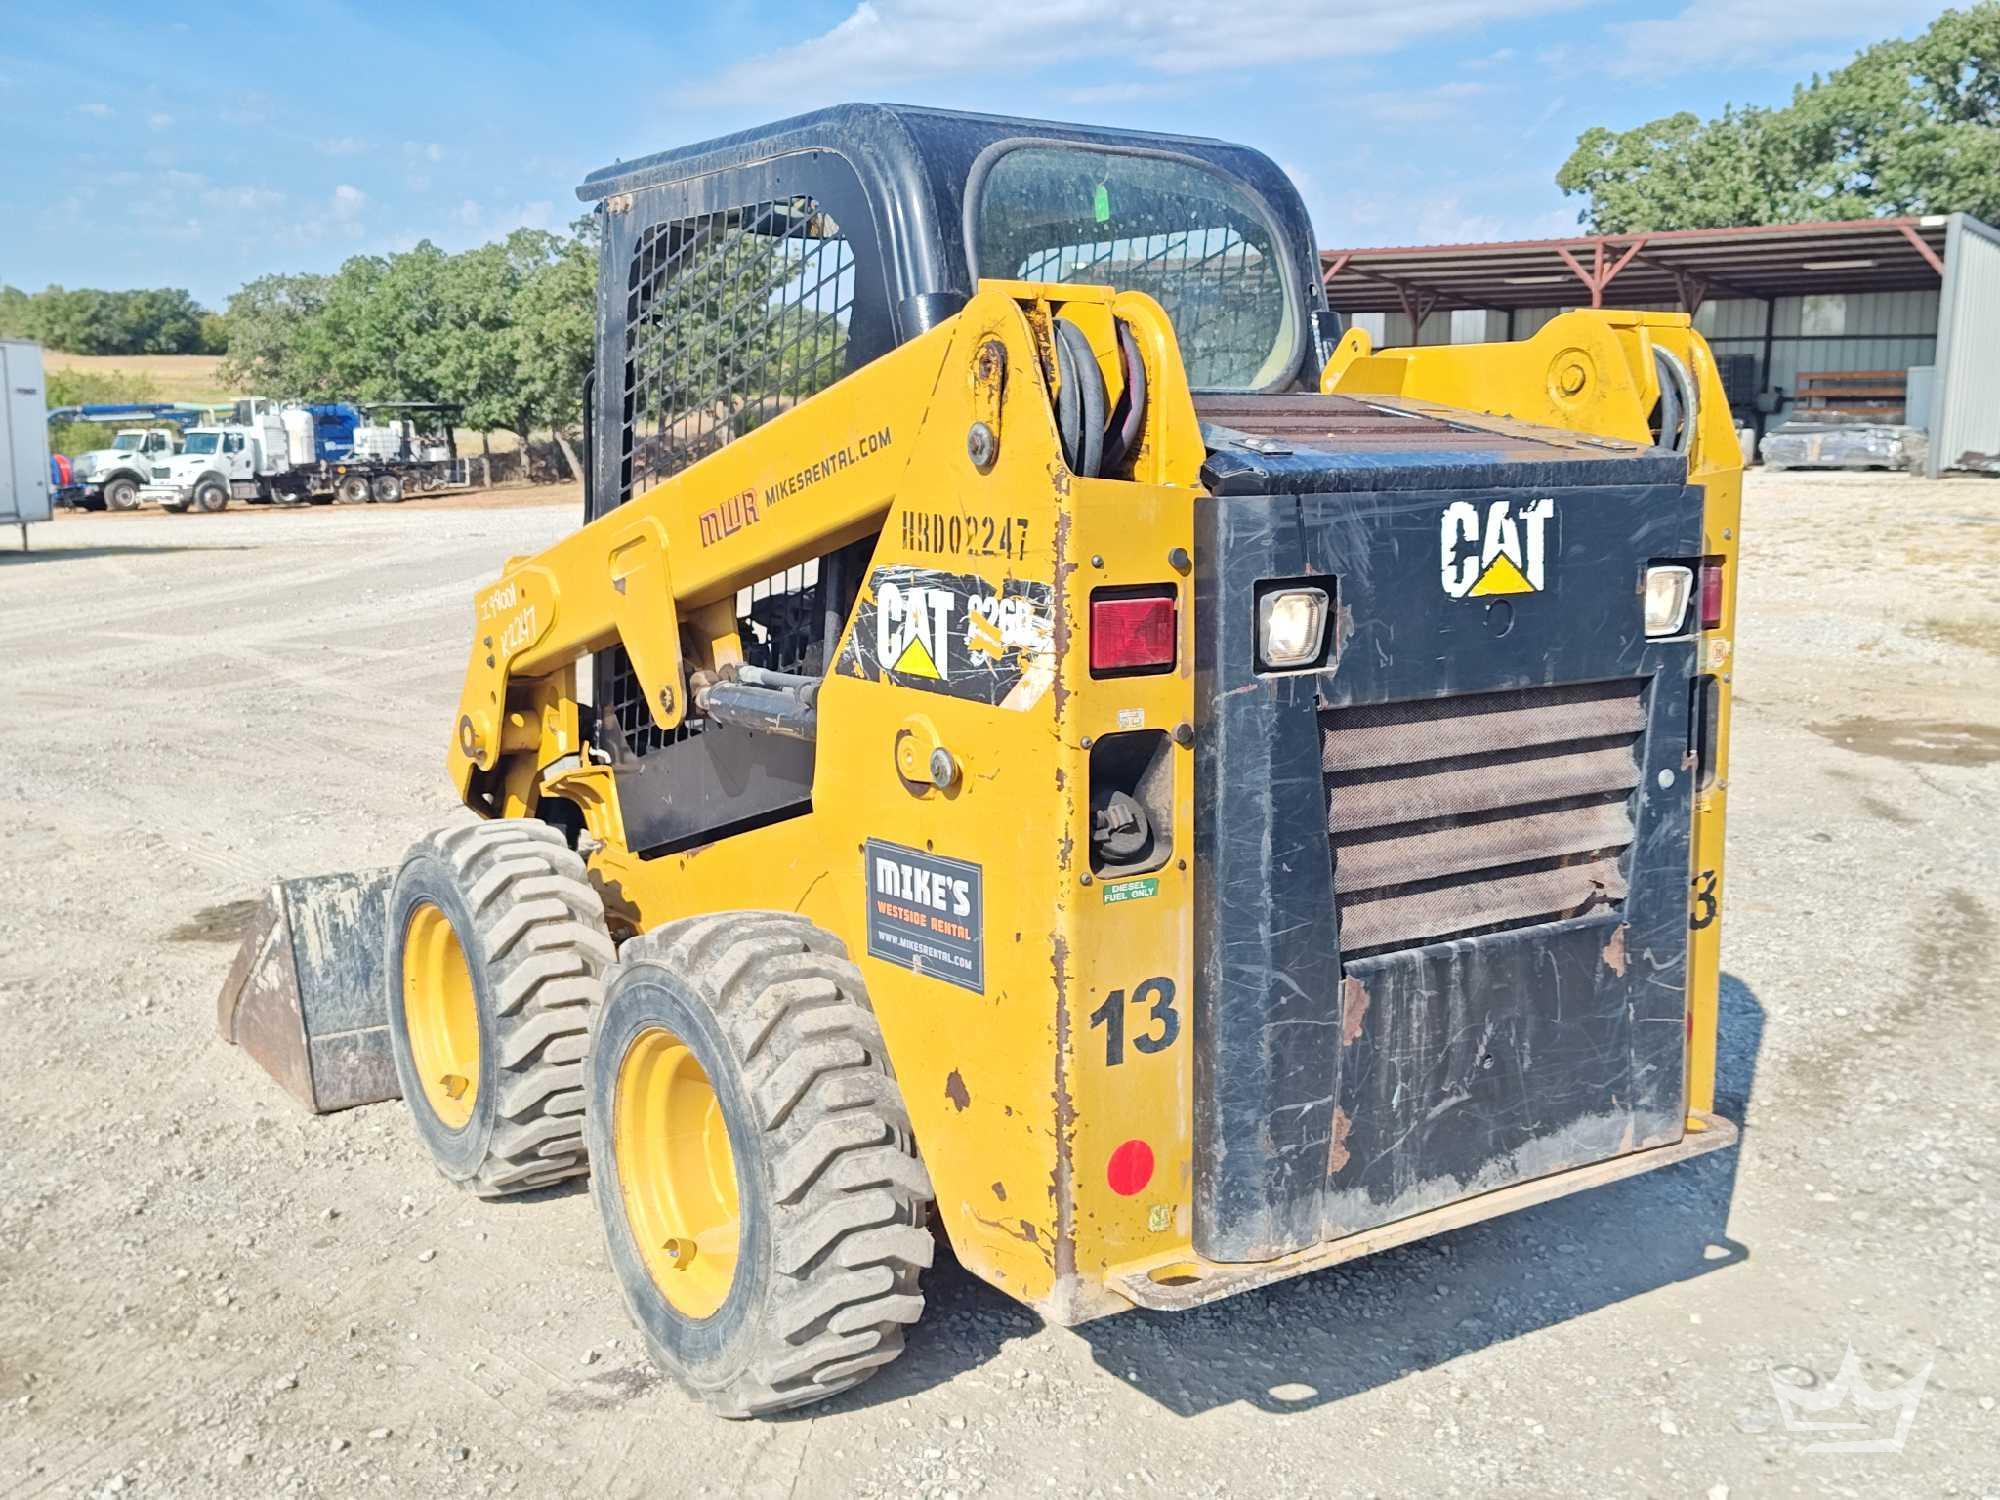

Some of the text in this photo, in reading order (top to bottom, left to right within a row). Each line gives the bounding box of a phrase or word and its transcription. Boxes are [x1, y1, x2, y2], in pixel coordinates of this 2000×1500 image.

[765, 427, 892, 507] MIKESRENTAL.COM
[1441, 498, 1554, 598] CAT
[876, 582, 954, 680] CAT
[876, 857, 971, 917] MIKE'S
[877, 900, 972, 941] WESTSIDE RENTAL
[1104, 887, 1154, 902] FUEL ONLY
[1111, 881, 1146, 893] DIESEL
[1090, 976, 1181, 1067] 13
